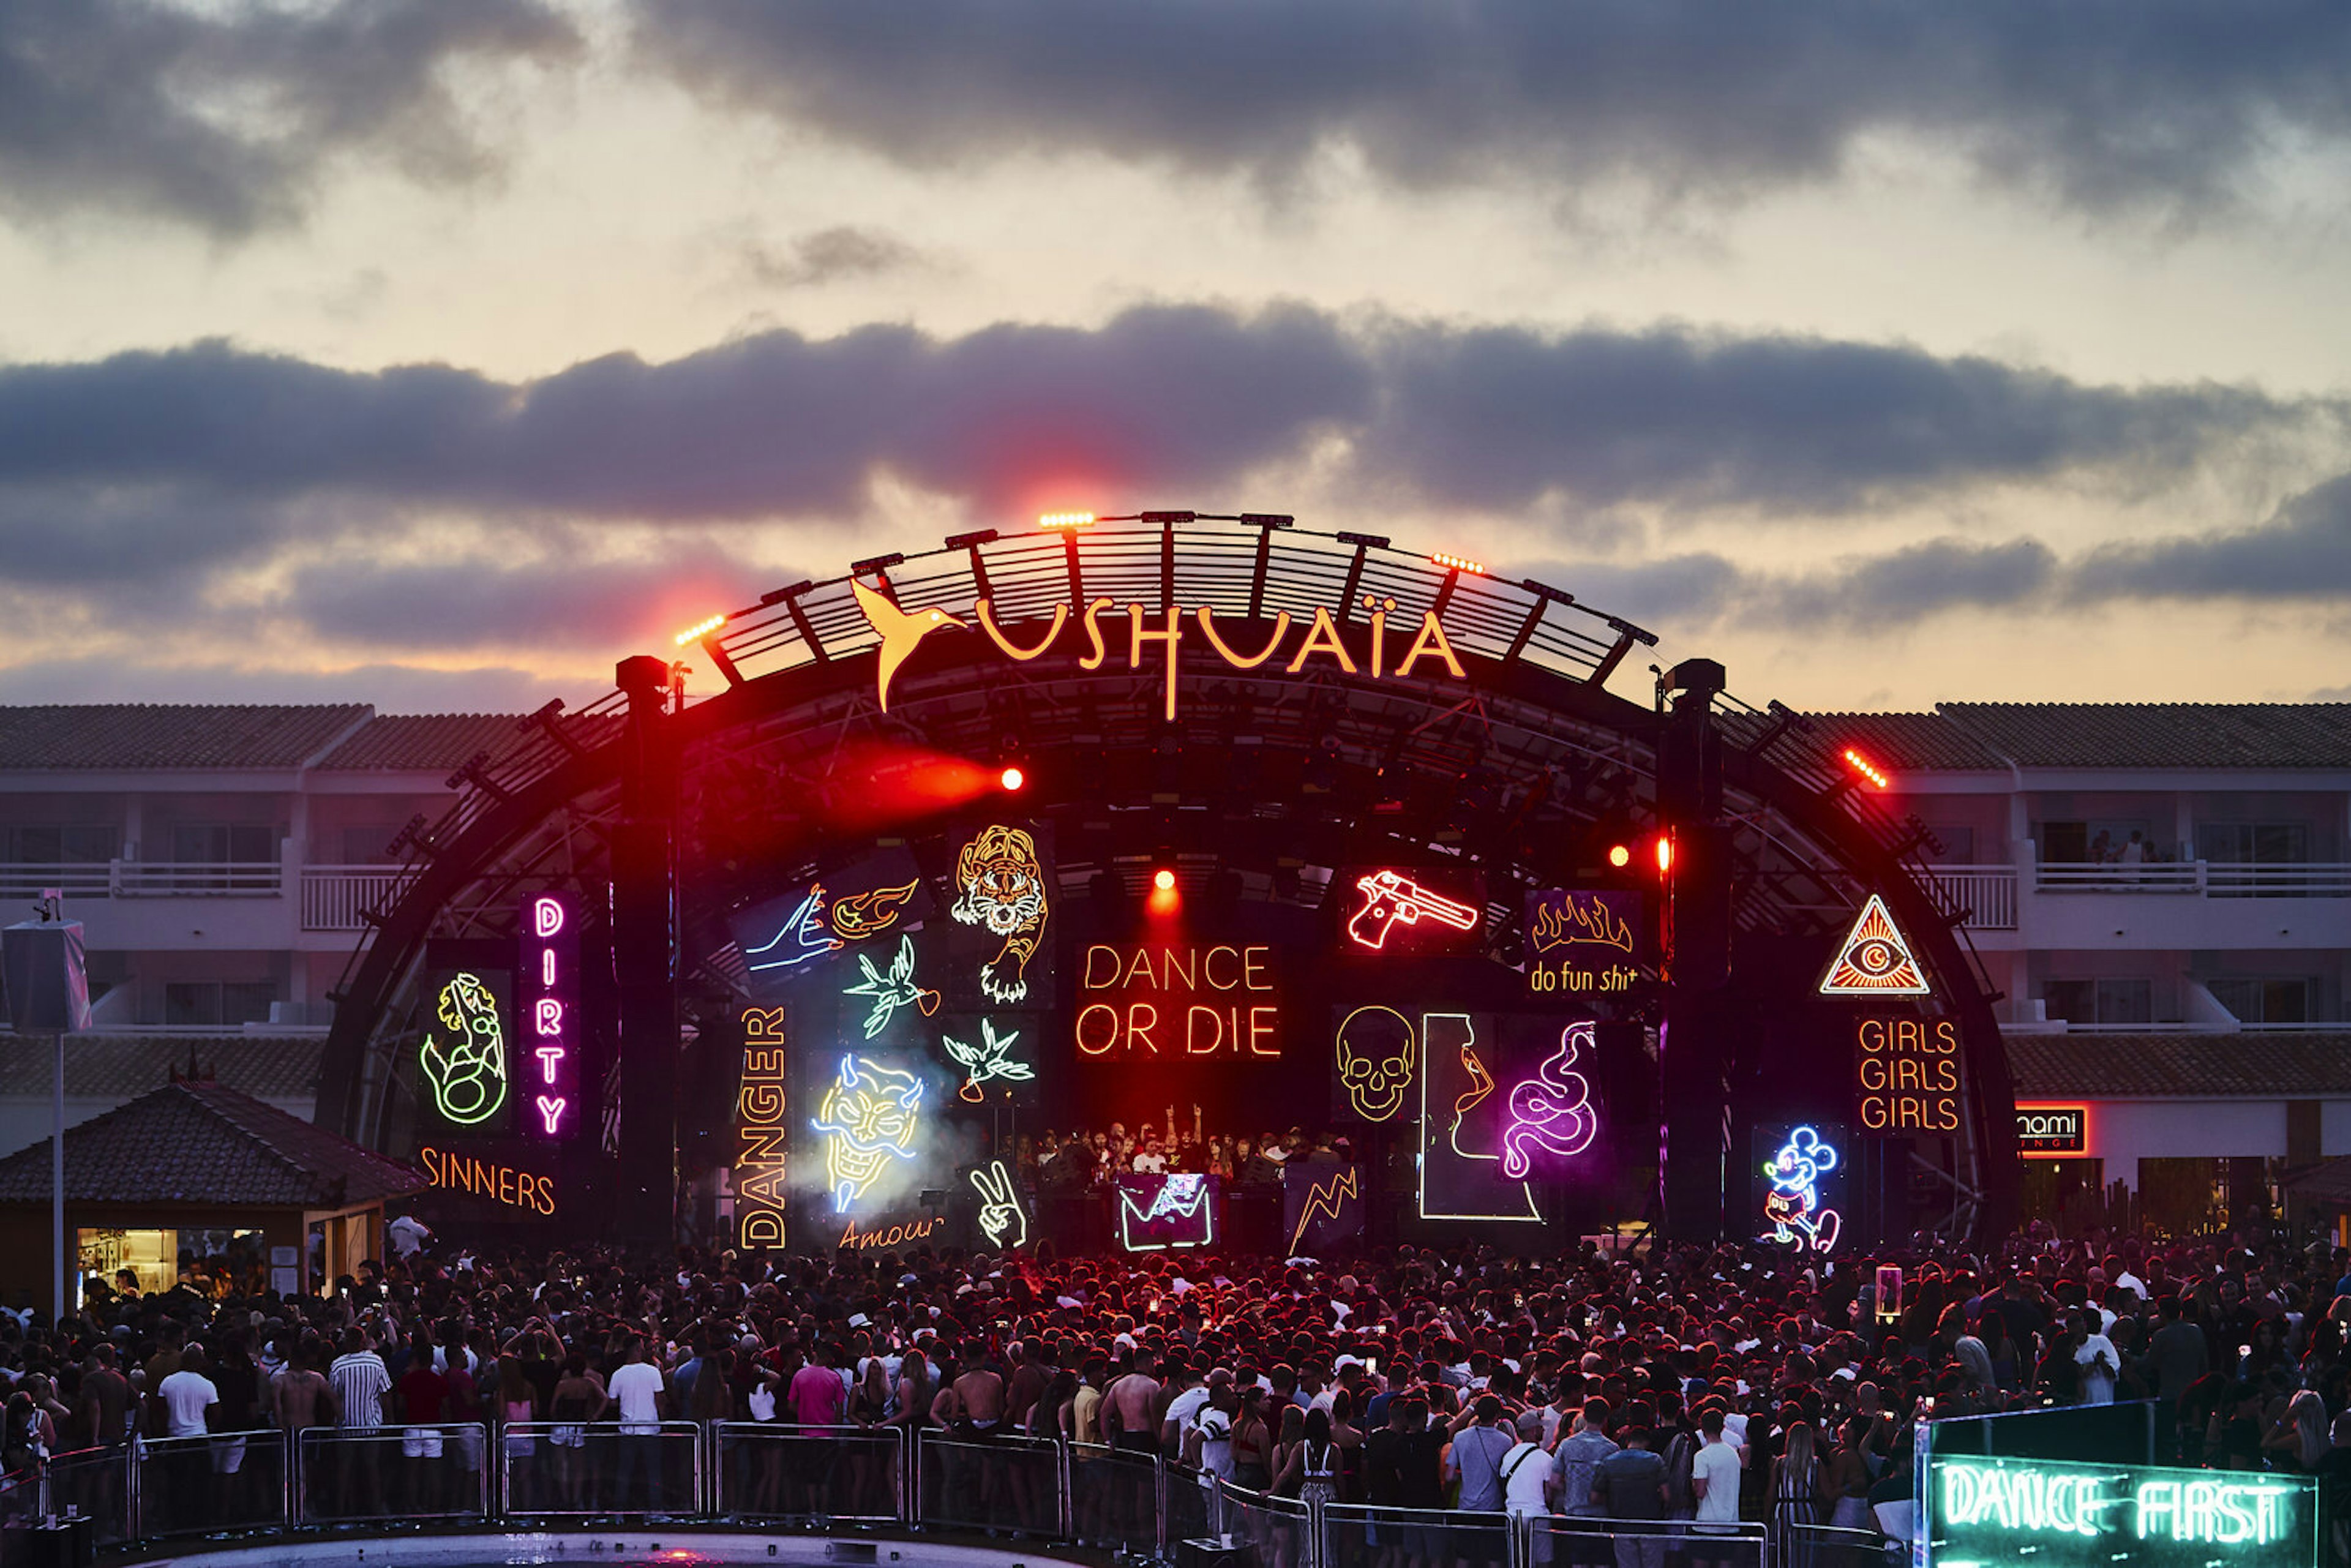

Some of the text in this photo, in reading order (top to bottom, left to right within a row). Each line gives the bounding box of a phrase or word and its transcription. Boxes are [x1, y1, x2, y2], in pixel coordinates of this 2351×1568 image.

[1084, 945, 1274, 991] DANCE
[1531, 960, 1556, 991] do
[1561, 960, 1592, 991] fun
[533, 897, 568, 1134] DIRTY
[1076, 1002, 1281, 1055] OR DIE
[1859, 1019, 1956, 1054] GIRLS
[1860, 1058, 1957, 1092] GIRLS
[740, 1005, 786, 1250] DANGER
[1861, 1097, 1958, 1130] GIRLS
[421, 1147, 555, 1215] SINNERS
[1943, 1465, 2287, 1545] DANCE FIRST
